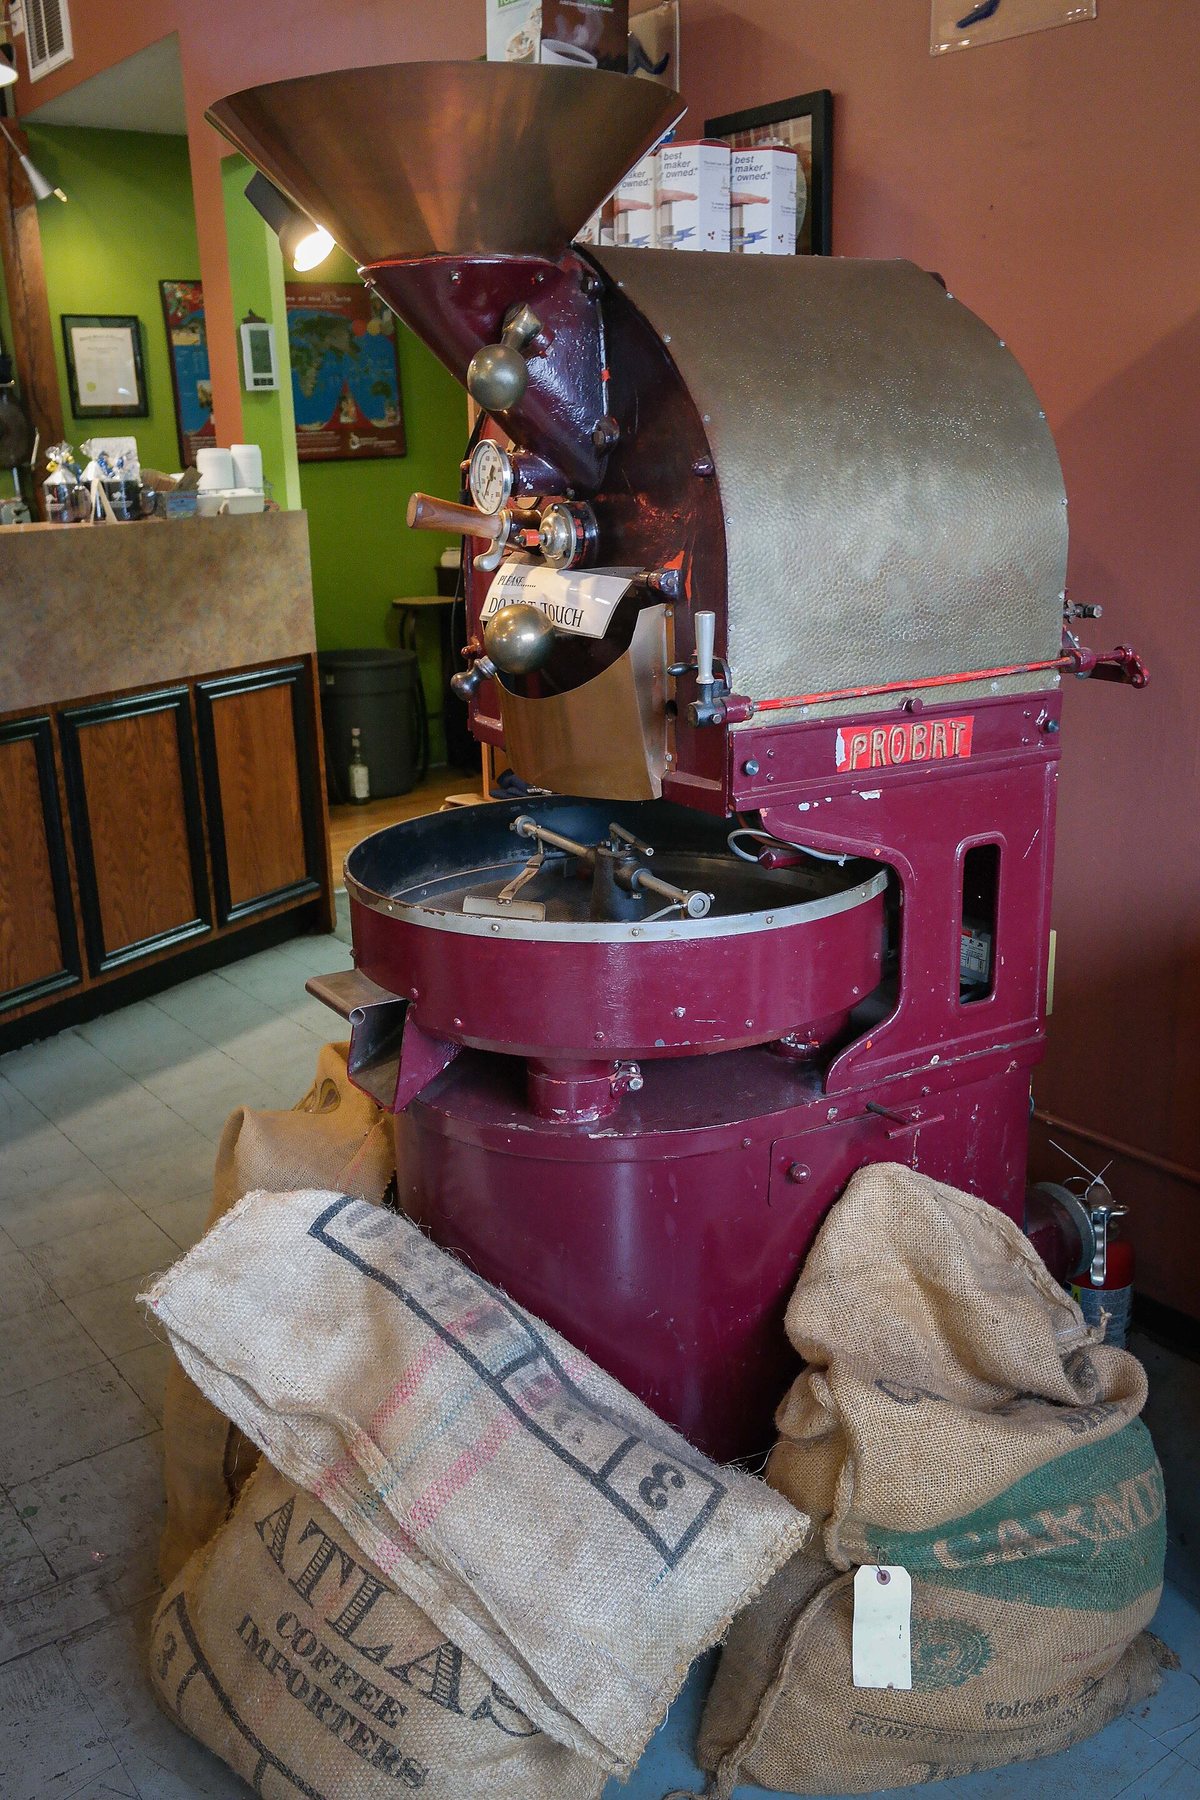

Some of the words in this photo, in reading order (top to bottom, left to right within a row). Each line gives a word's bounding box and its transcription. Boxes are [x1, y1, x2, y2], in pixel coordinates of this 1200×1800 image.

[664, 152, 682, 160] best
[664, 160, 691, 169] maker
[735, 156, 754, 164] best
[735, 164, 763, 173] maker
[488, 597, 506, 613] DO
[540, 602, 585, 628] TOUCH
[850, 721, 966, 770] PROBAT
[276, 1611, 409, 1730] COFFEE
[235, 1613, 430, 1790] IMPORTERS
